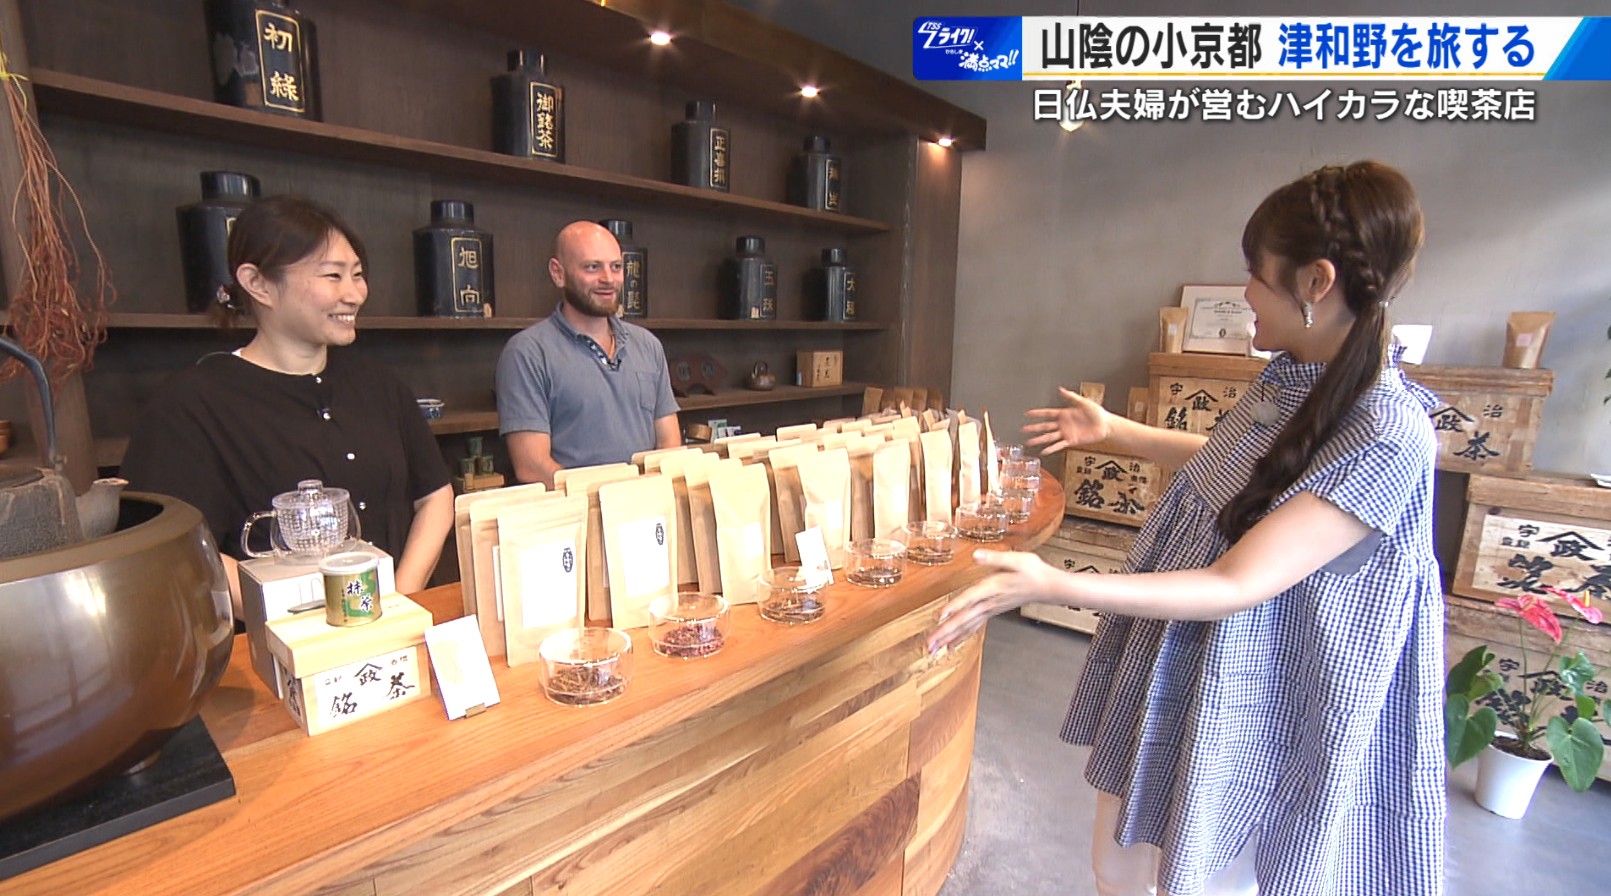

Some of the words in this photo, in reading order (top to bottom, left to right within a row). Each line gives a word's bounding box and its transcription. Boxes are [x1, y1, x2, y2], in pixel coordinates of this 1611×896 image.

[1170, 382, 1183, 395] 宇
[1483, 404, 1503, 418] 治
[1518, 524, 1540, 538] 宇
